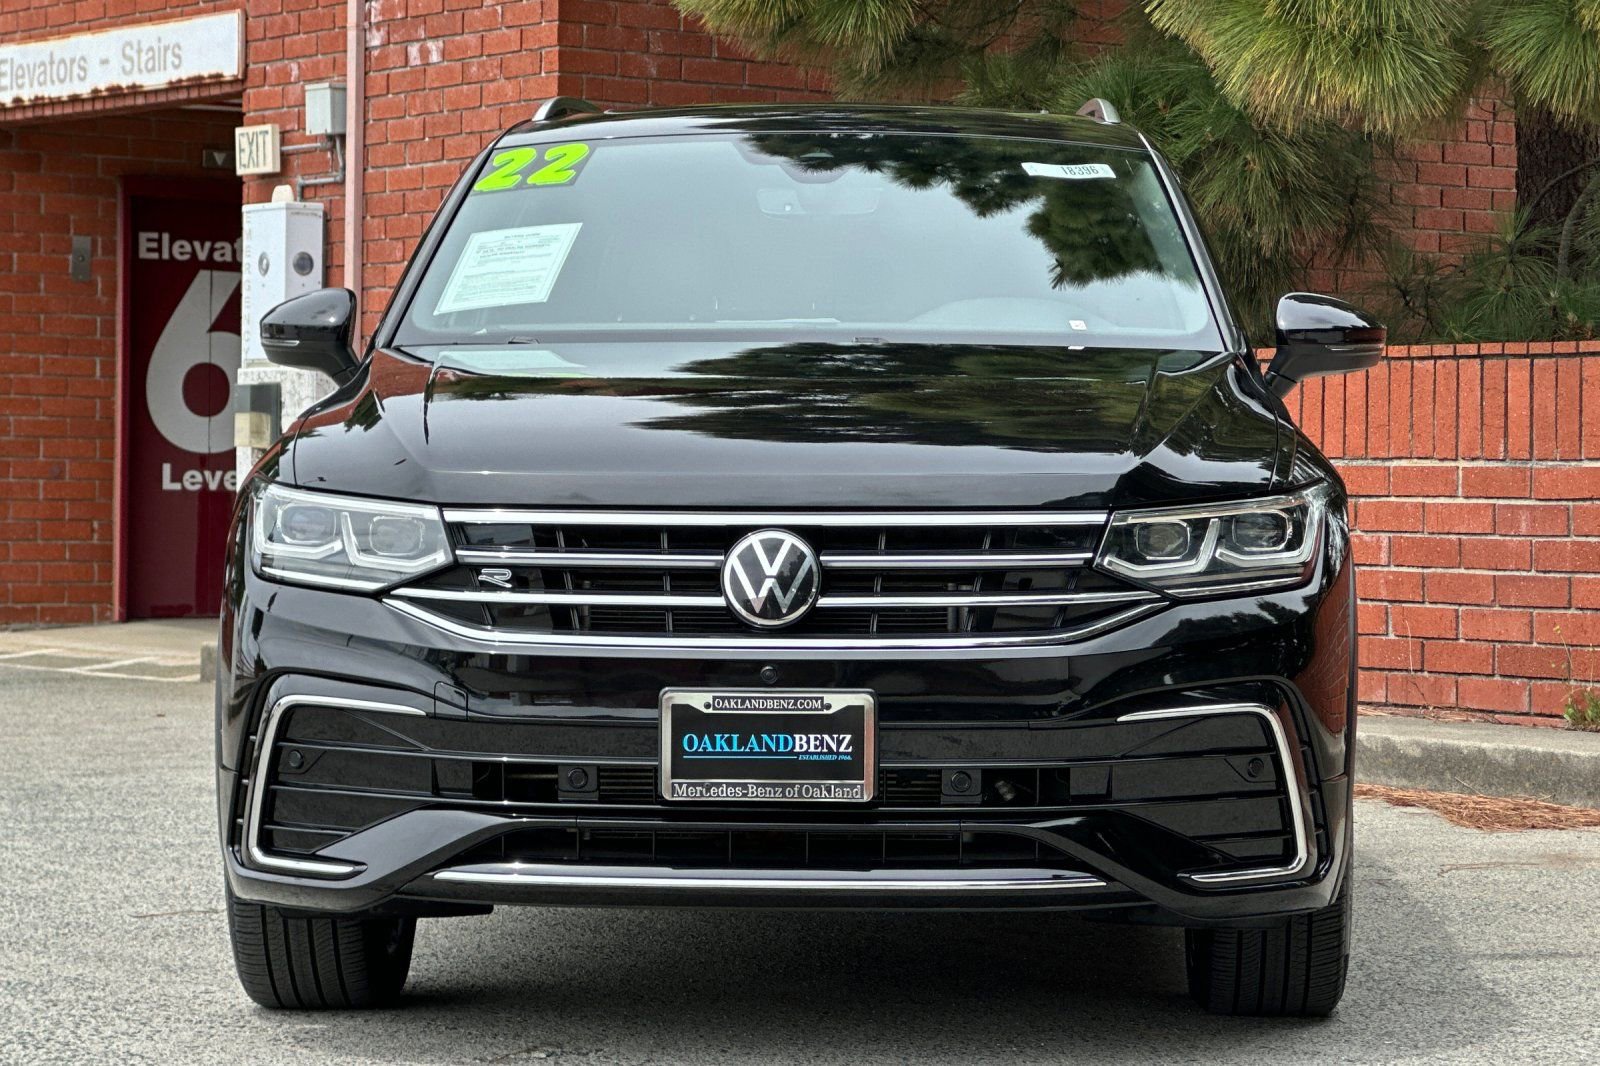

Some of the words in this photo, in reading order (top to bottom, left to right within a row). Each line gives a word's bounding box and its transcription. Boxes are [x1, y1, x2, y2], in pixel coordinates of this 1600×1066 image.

[0, 50, 88, 92] Elevators
[121, 36, 183, 77] Stairs
[238, 130, 270, 170] EXIT
[473, 142, 590, 193] 22
[146, 268, 242, 454] 6
[714, 698, 822, 710] OAKLANDBENZ.COM
[682, 733, 853, 753] OAKLANDBENZ
[673, 783, 783, 798] Mercedes-Benz
[785, 783, 800, 798] of
[801, 783, 862, 799] Oakland
